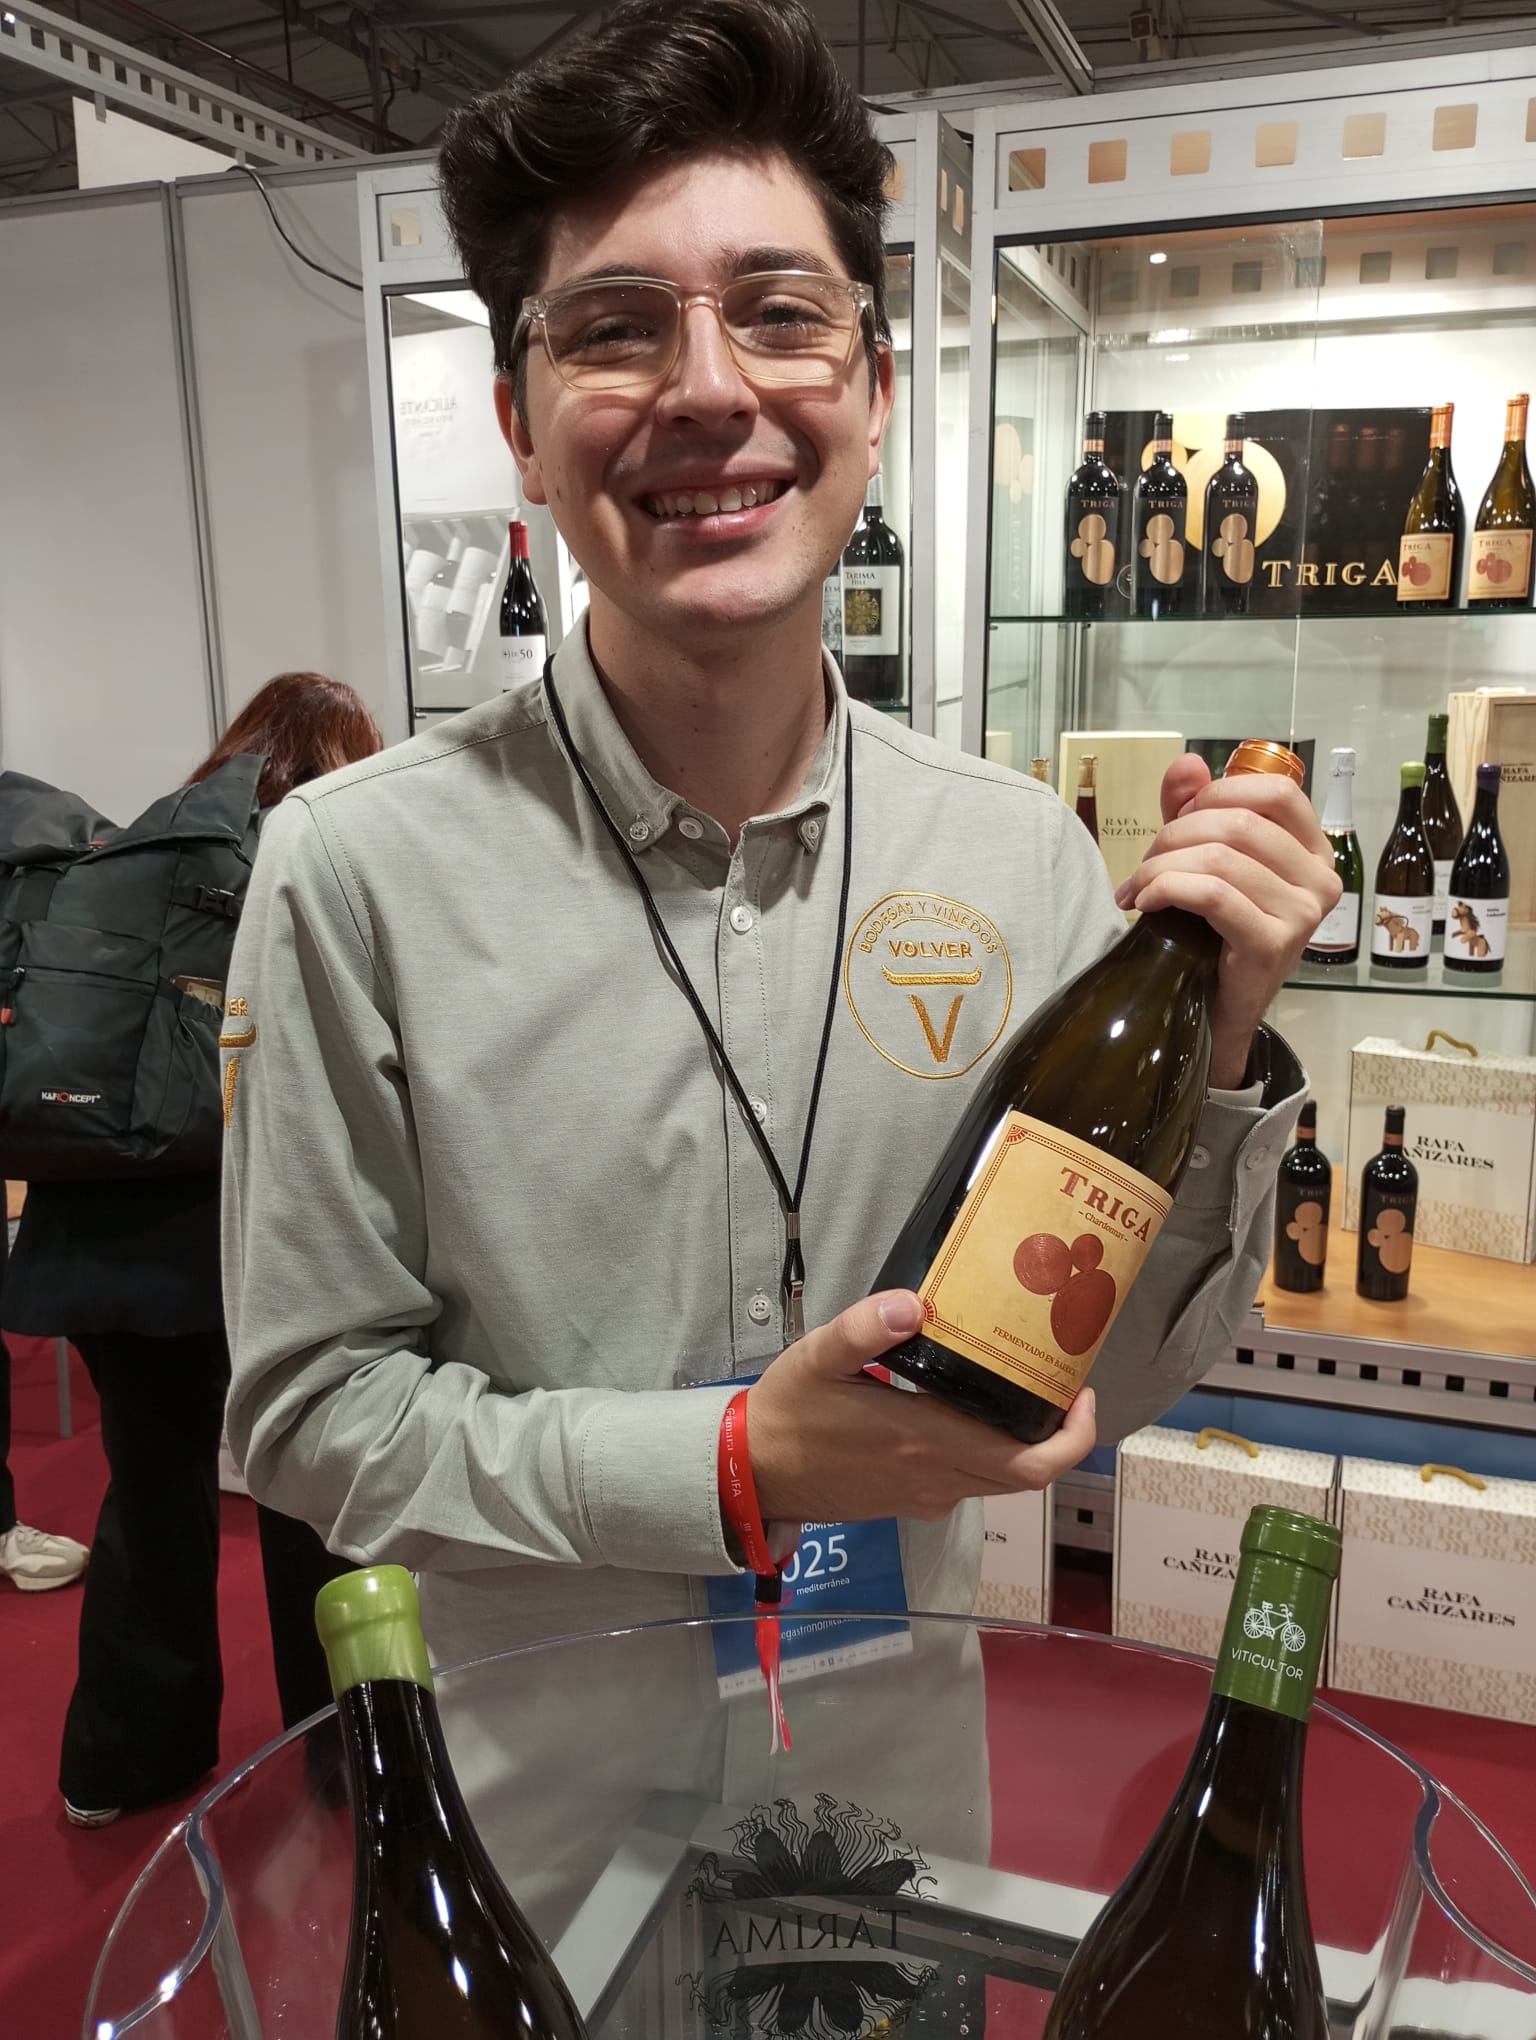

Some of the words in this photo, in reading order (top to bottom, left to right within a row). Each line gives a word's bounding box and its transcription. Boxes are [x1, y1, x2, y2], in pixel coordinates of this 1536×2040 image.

[1081, 499, 1115, 509] TRIGA
[1148, 499, 1184, 509] TRIGA
[1479, 539, 1513, 548] TRIGA
[846, 571, 876, 580] TARIMA
[1261, 559, 1398, 588] TRIGA
[519, 648, 533, 660] 50
[1101, 825, 1157, 836] ÑIZARES
[1105, 817, 1139, 826] RAFA
[858, 901, 913, 954] BODEGAS
[918, 901, 927, 914] Y
[888, 940, 973, 959] VOLVER
[1416, 1135, 1465, 1153] RAFA
[1402, 1146, 1494, 1170] AÑIZARES
[1060, 1166, 1151, 1243] TRIGA
[1084, 1211, 1125, 1241] Chardonnay
[992, 1326, 1045, 1359] FERMENTADO
[1044, 1353, 1055, 1364] EN
[730, 1479, 742, 1497] IFA
[1195, 1547, 1238, 1566] RAF
[1163, 1556, 1236, 1580] CAÑIZA
[796, 1577, 850, 1597] mediterránea
[1423, 1587, 1481, 1607] RAFA
[1387, 1595, 1516, 1627] CAÑIZARES
[1232, 1647, 1304, 1681] VITICULTOR
